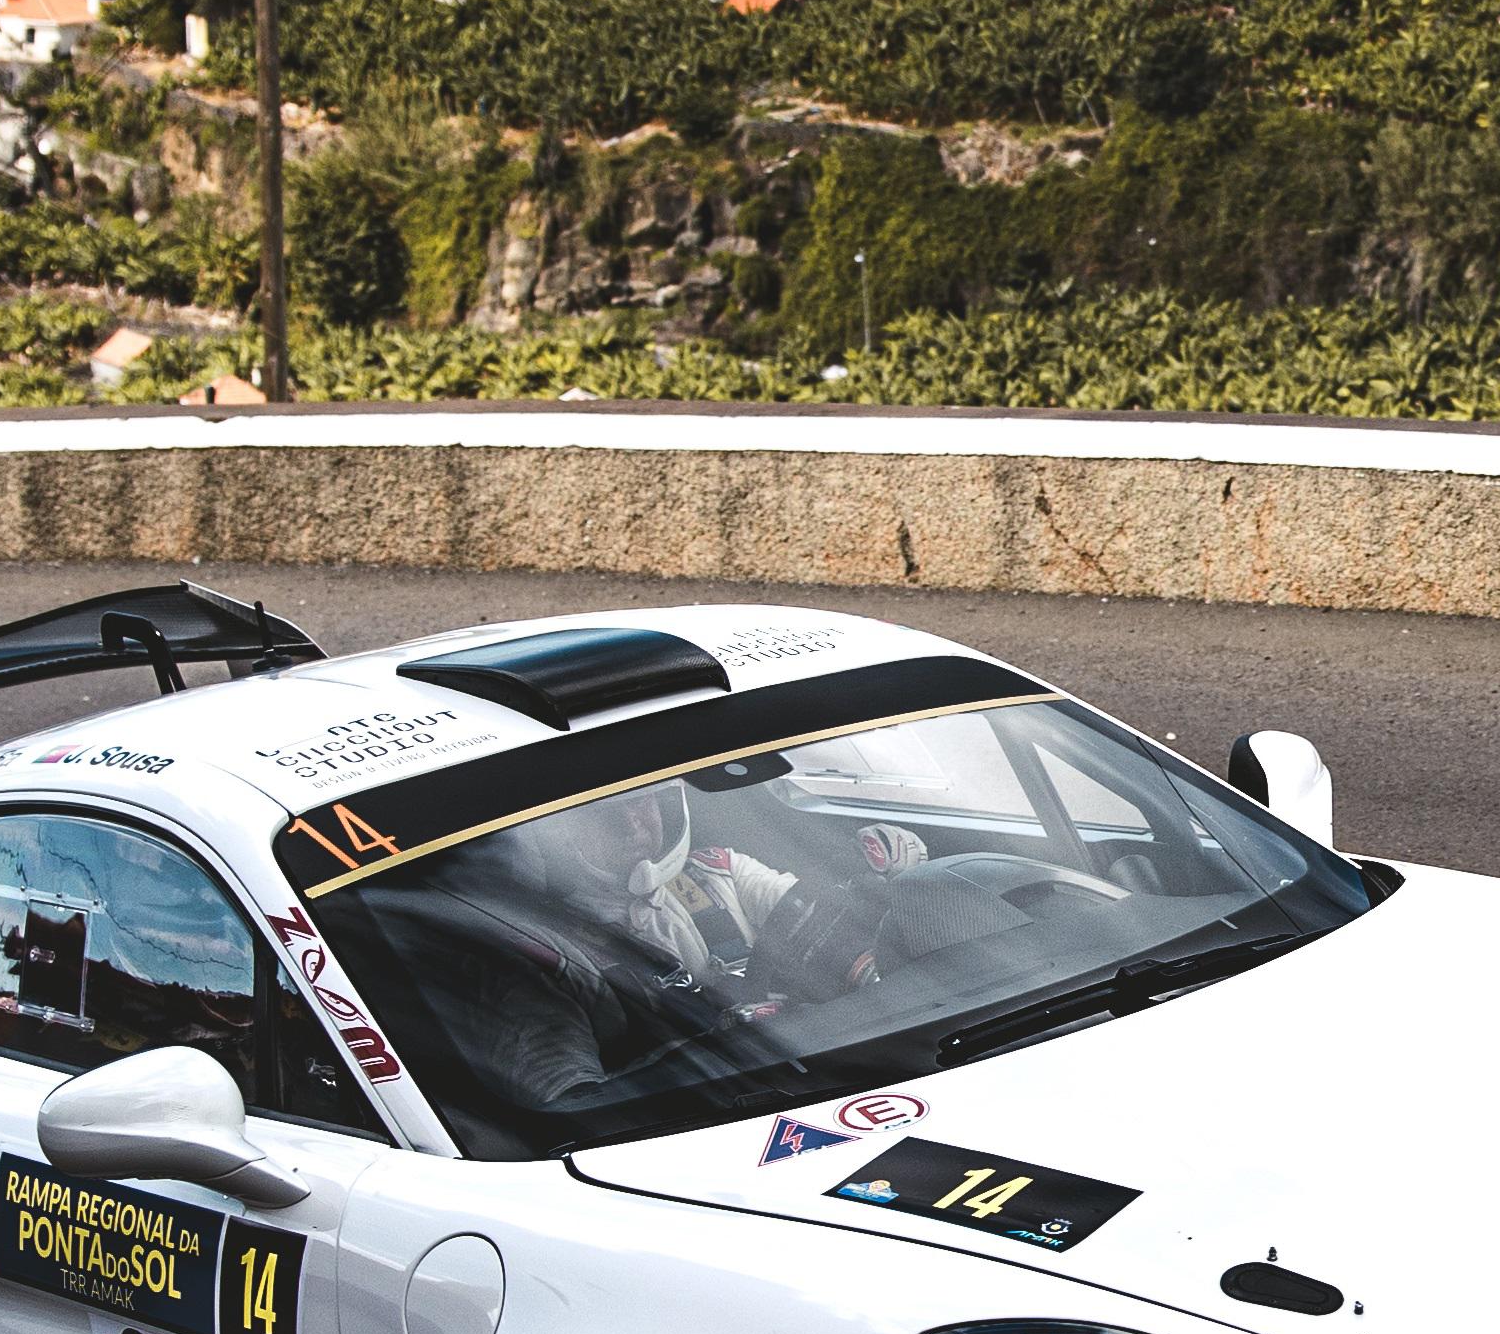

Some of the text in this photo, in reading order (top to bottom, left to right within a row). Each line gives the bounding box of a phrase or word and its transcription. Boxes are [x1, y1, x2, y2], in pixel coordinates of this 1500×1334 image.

[90, 745, 176, 775] Sousa
[294, 732, 435, 779] STUDIO
[312, 770, 362, 789] DESIGN
[287, 803, 401, 869] 14
[6, 1170, 200, 1257] RAMPA REGIONAL DA
[931, 1167, 1035, 1219] 14
[60, 1268, 136, 1311] TRR AMAK
